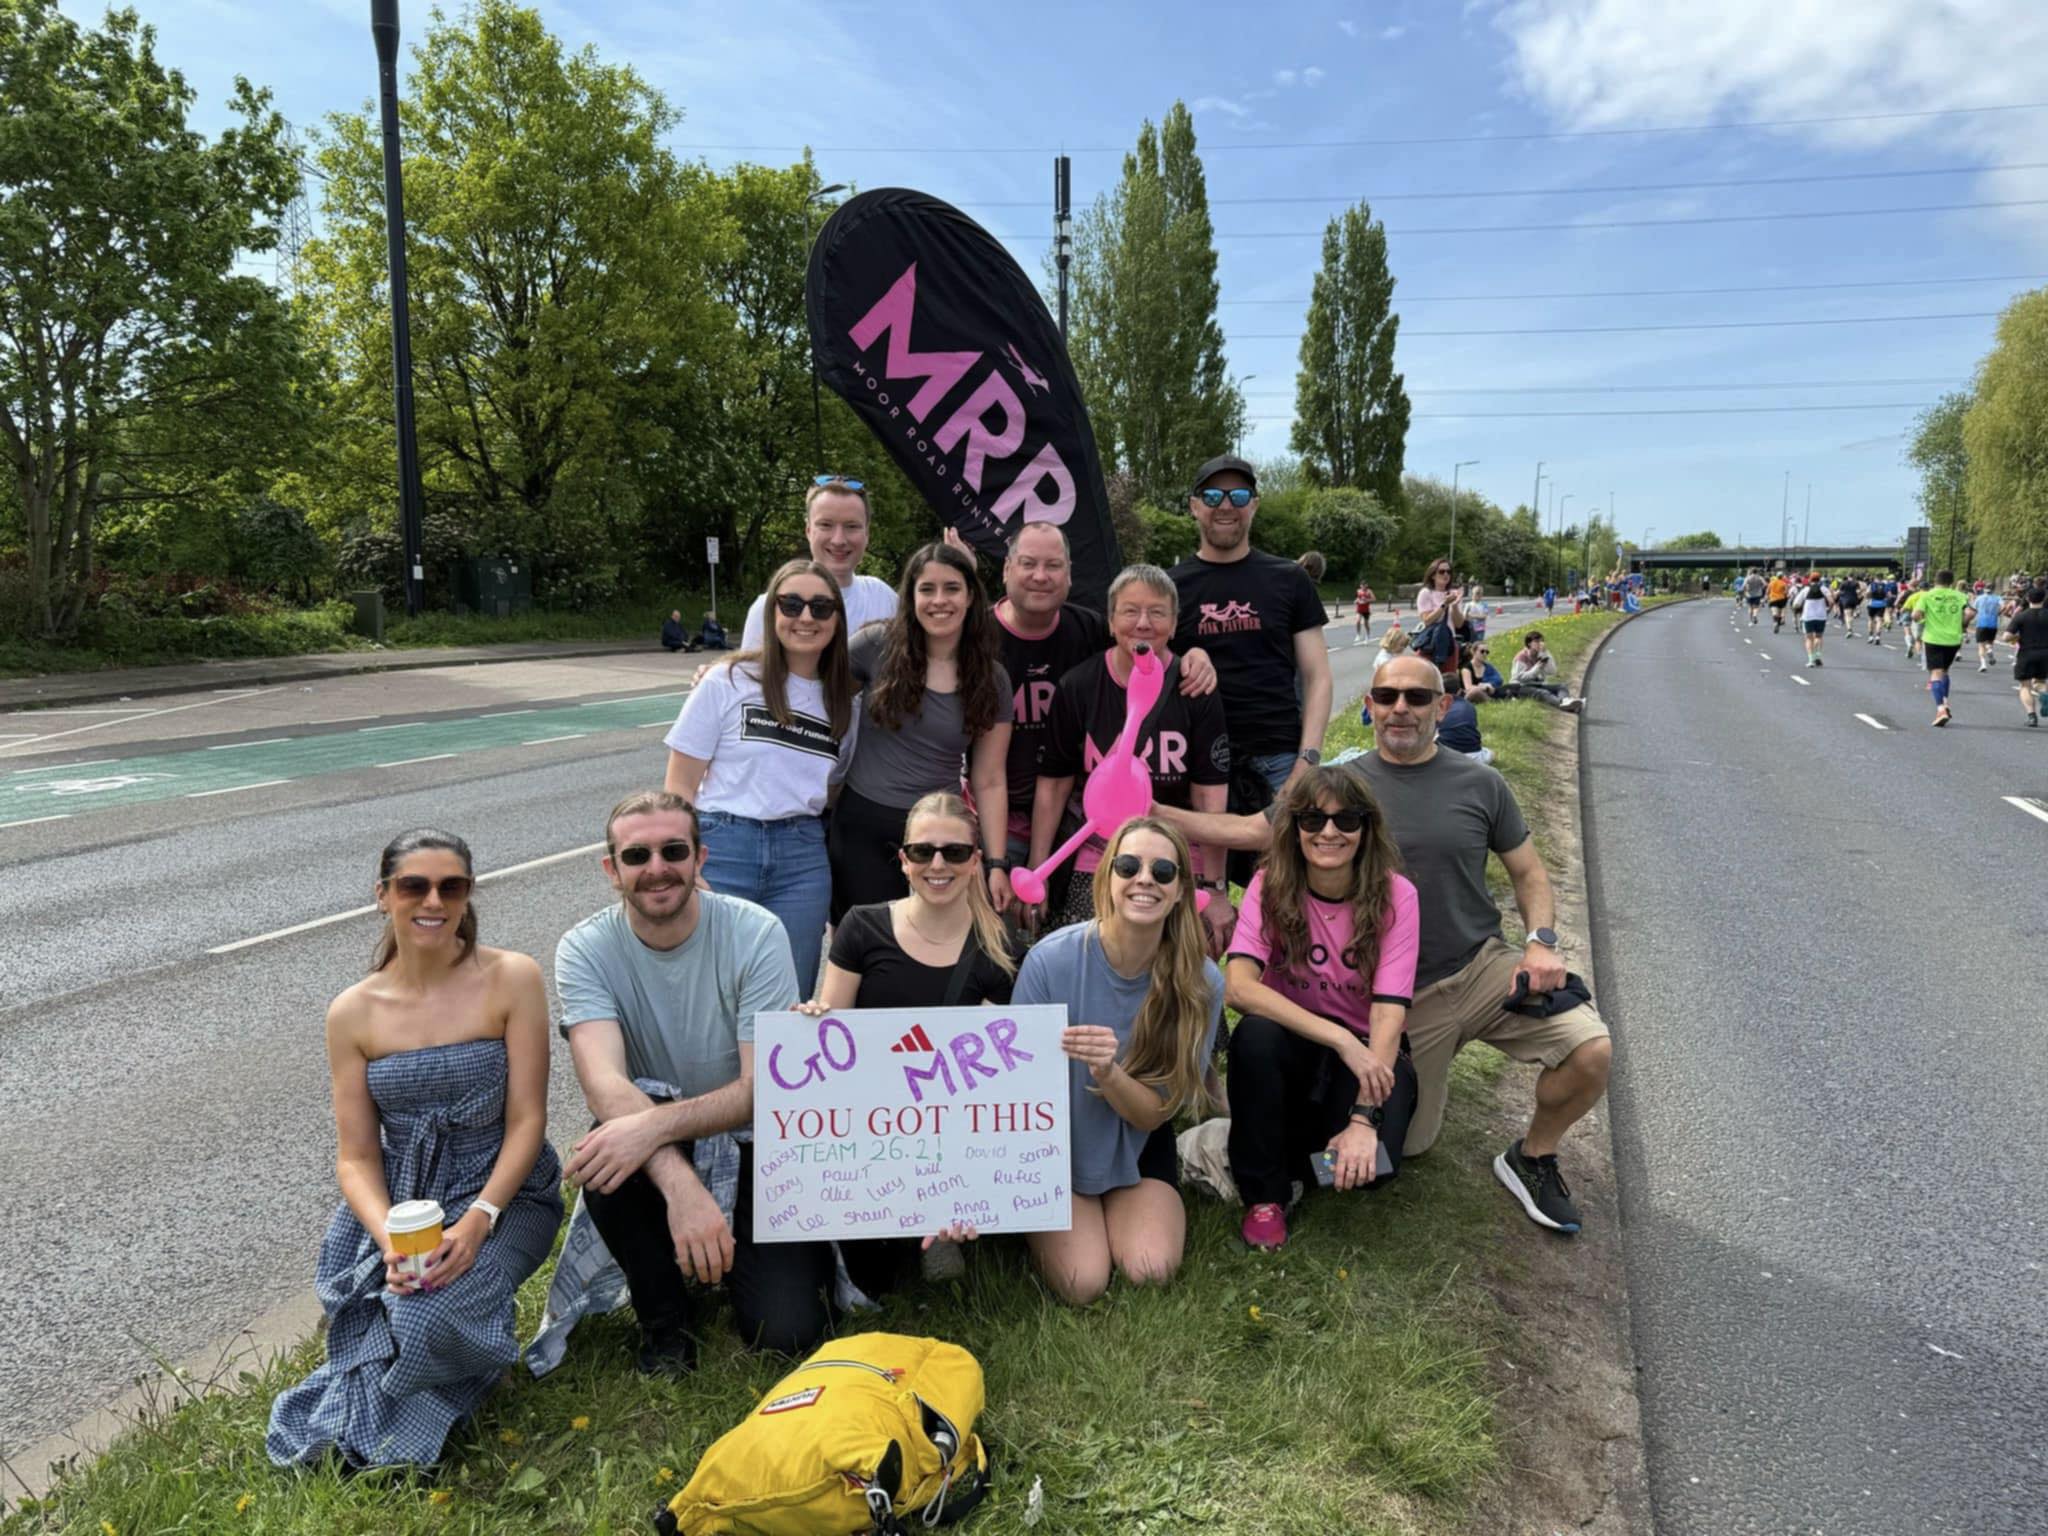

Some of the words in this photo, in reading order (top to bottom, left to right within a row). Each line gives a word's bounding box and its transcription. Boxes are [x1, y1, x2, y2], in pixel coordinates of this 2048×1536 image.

[848, 261, 1076, 526] MRR
[853, 361, 900, 419] MOOR
[906, 426, 947, 476] ROAD
[750, 717, 780, 729] moor
[768, 1018, 856, 1090] GO
[903, 1018, 1034, 1103] MRR
[772, 1107, 853, 1140] YOU
[868, 1104, 949, 1136] GOT
[964, 1101, 1055, 1133] THIS
[795, 1141, 857, 1164] TEAM
[916, 1174, 970, 1202] Adam
[994, 1169, 1041, 1184] Rufus
[953, 1199, 990, 1215] Anna
[1013, 1191, 1048, 1212] Paul
[1054, 1184, 1064, 1201] A
[768, 1204, 799, 1229] Anna
